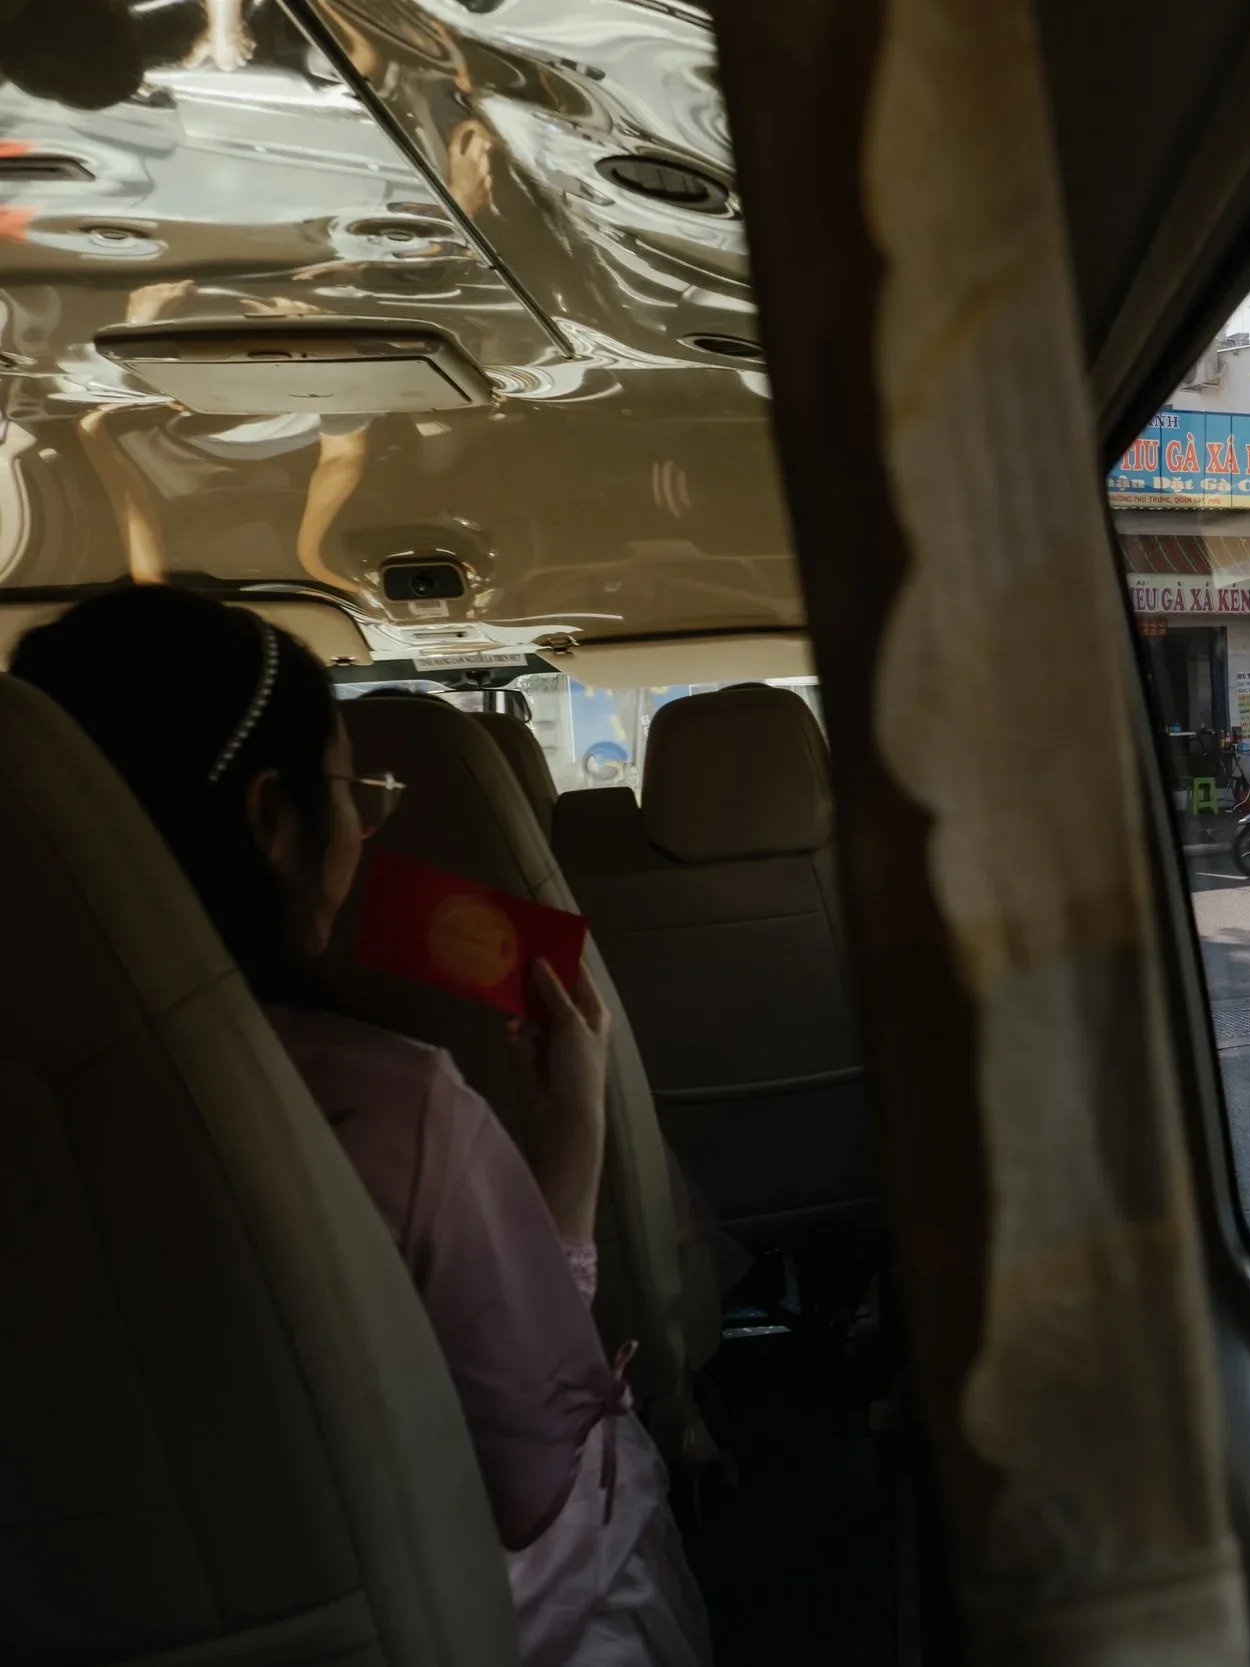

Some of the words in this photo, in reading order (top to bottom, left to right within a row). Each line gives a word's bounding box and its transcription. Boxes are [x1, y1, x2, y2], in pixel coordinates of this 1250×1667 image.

[1165, 431, 1200, 473] GÀ
[1206, 432, 1240, 474] XÁ
[1161, 582, 1186, 612] GÀ
[1190, 581, 1213, 611] XÁ
